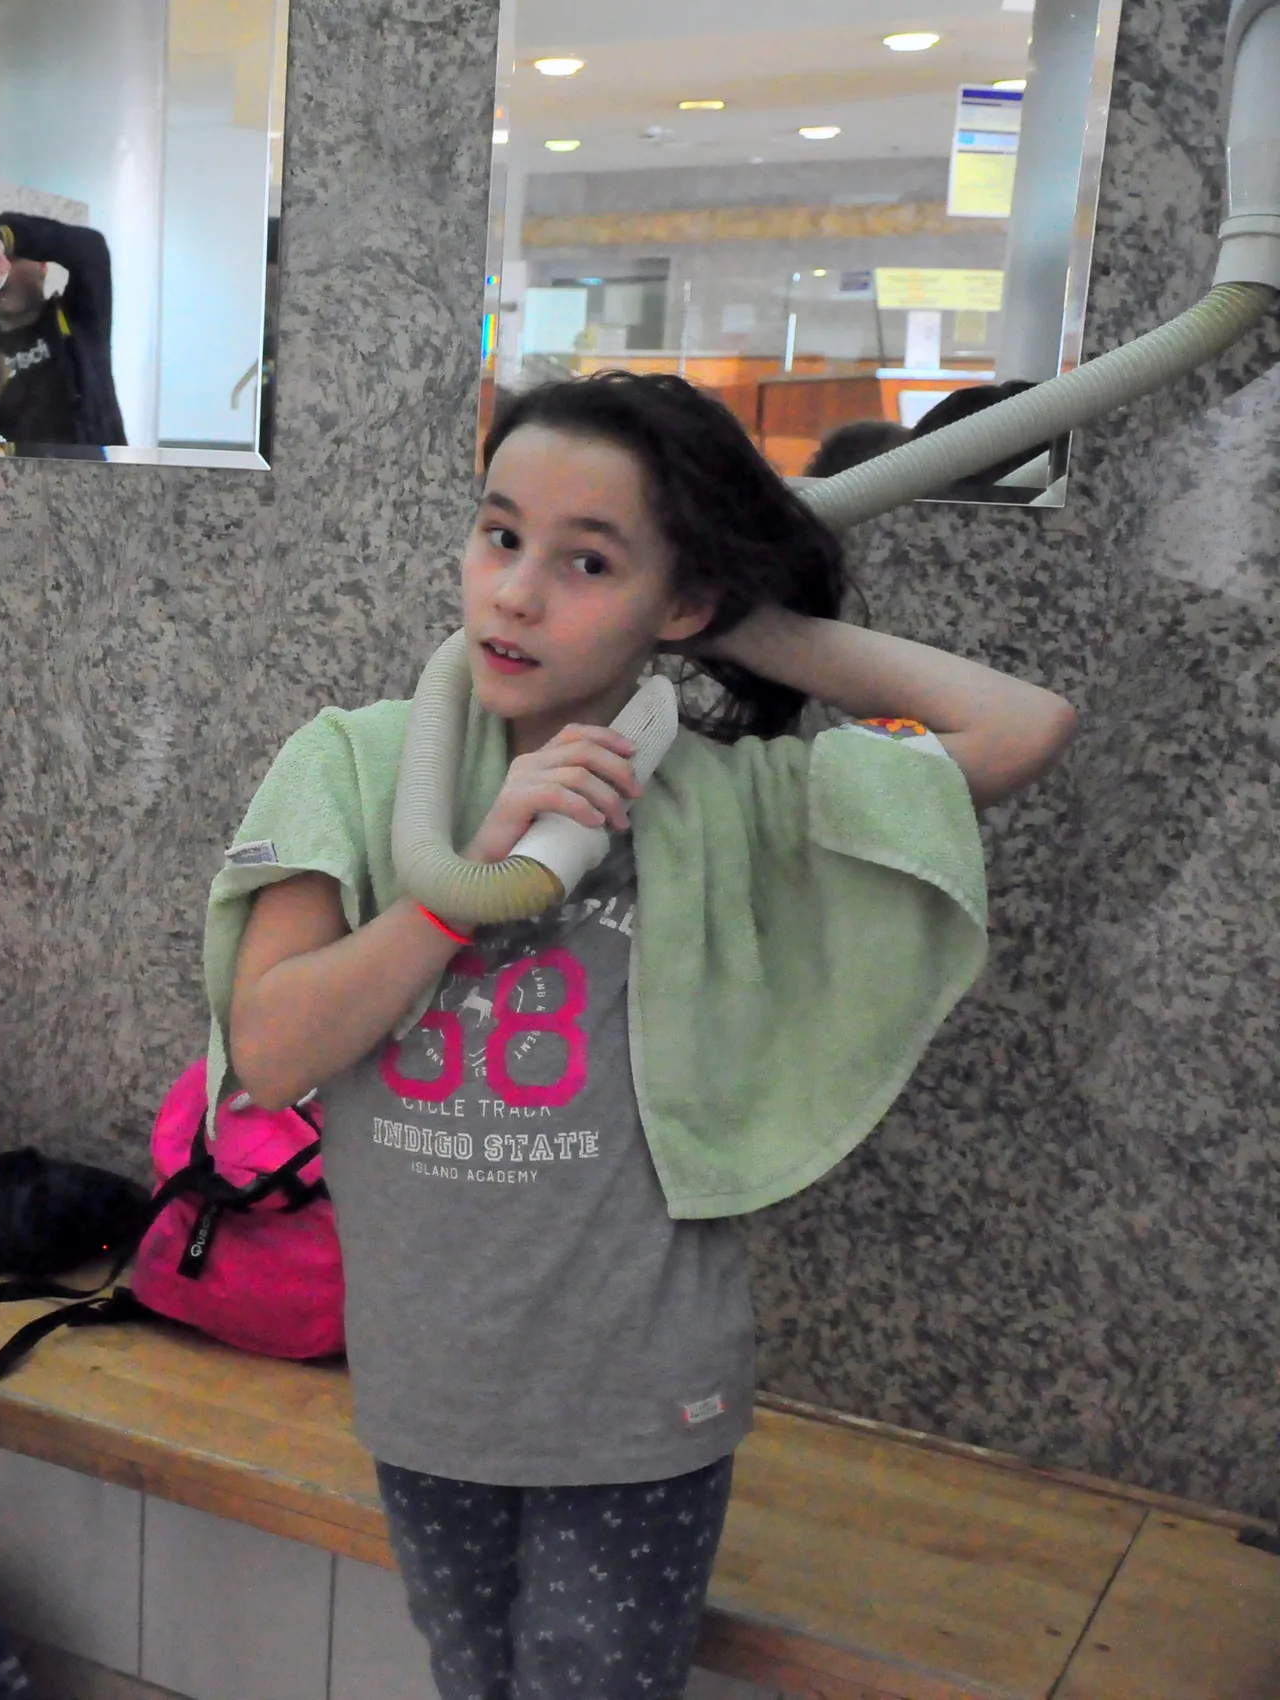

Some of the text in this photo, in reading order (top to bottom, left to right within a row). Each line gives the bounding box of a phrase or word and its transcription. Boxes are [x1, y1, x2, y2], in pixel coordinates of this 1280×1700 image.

[373, 1117, 600, 1162] INDIGO STATE
[411, 1161, 539, 1184] ISLAND ACADEMY
